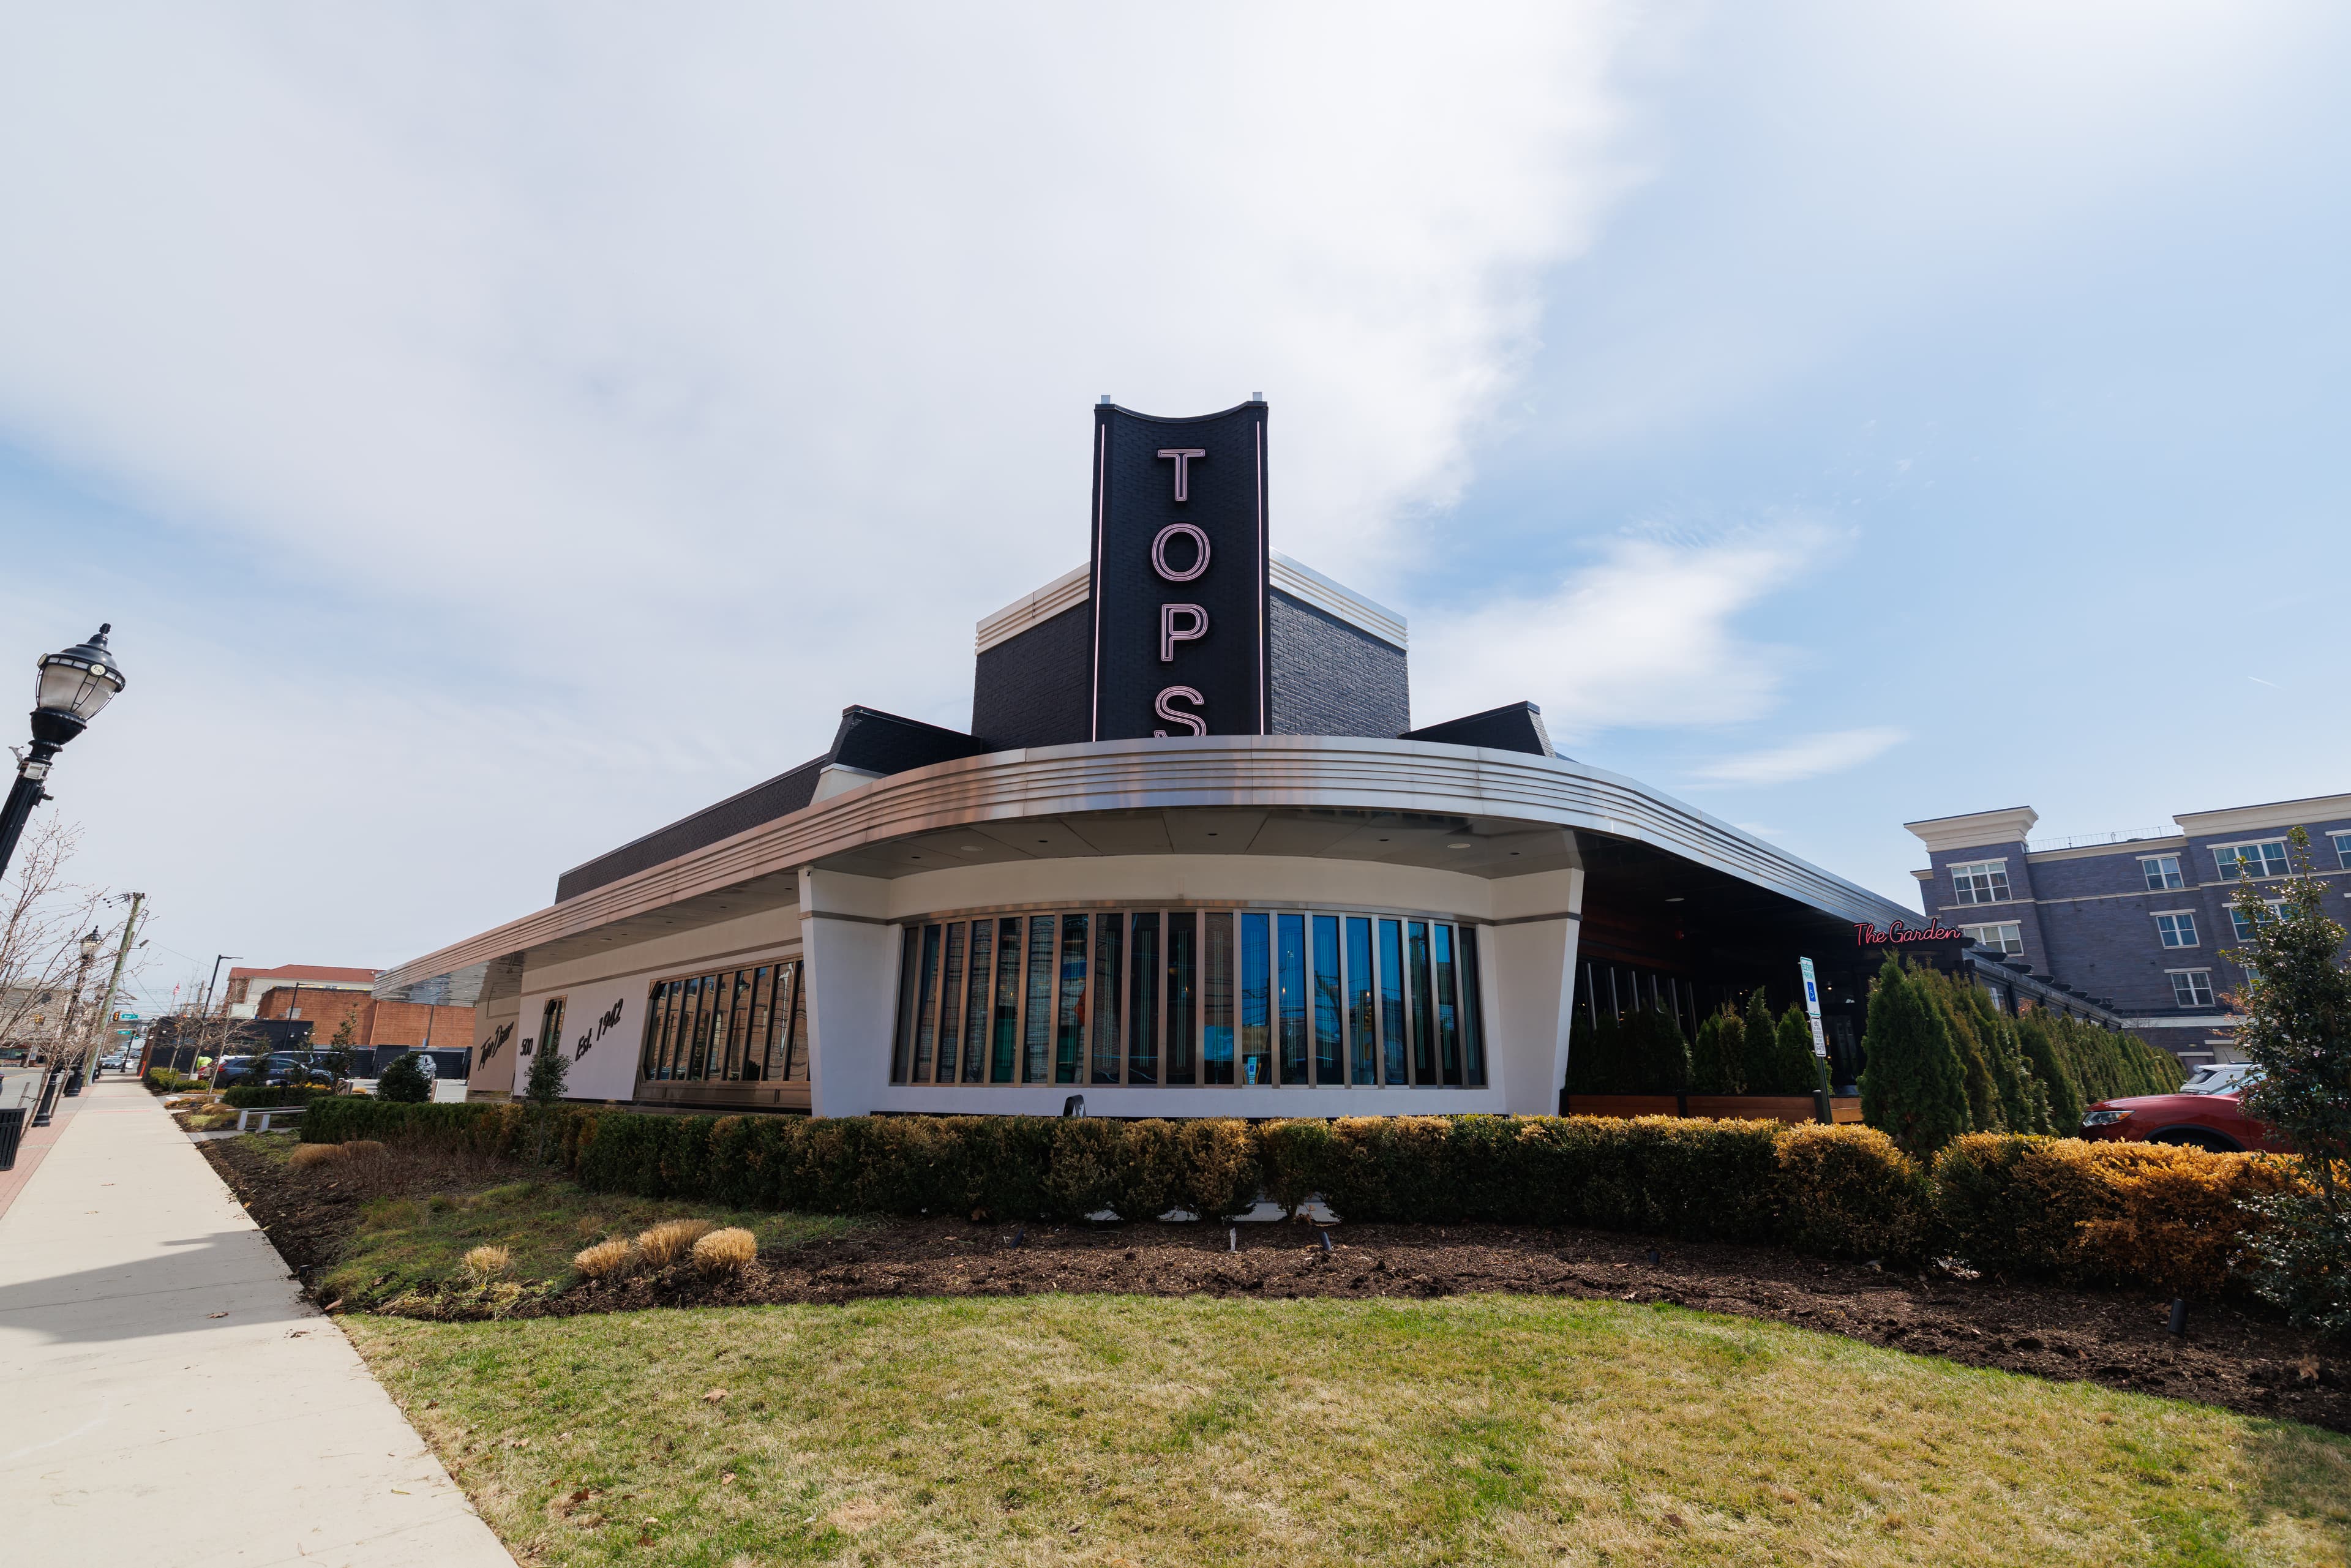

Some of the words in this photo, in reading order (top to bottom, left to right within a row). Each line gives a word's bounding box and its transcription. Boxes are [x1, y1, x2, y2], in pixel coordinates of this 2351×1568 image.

[1152, 448, 1210, 738] TOPS
[1853, 923, 1888, 946] The
[1889, 918, 1961, 943] Garden
[520, 1038, 533, 1056] 500
[575, 1027, 592, 1062] Est.
[596, 998, 623, 1041] 1942
